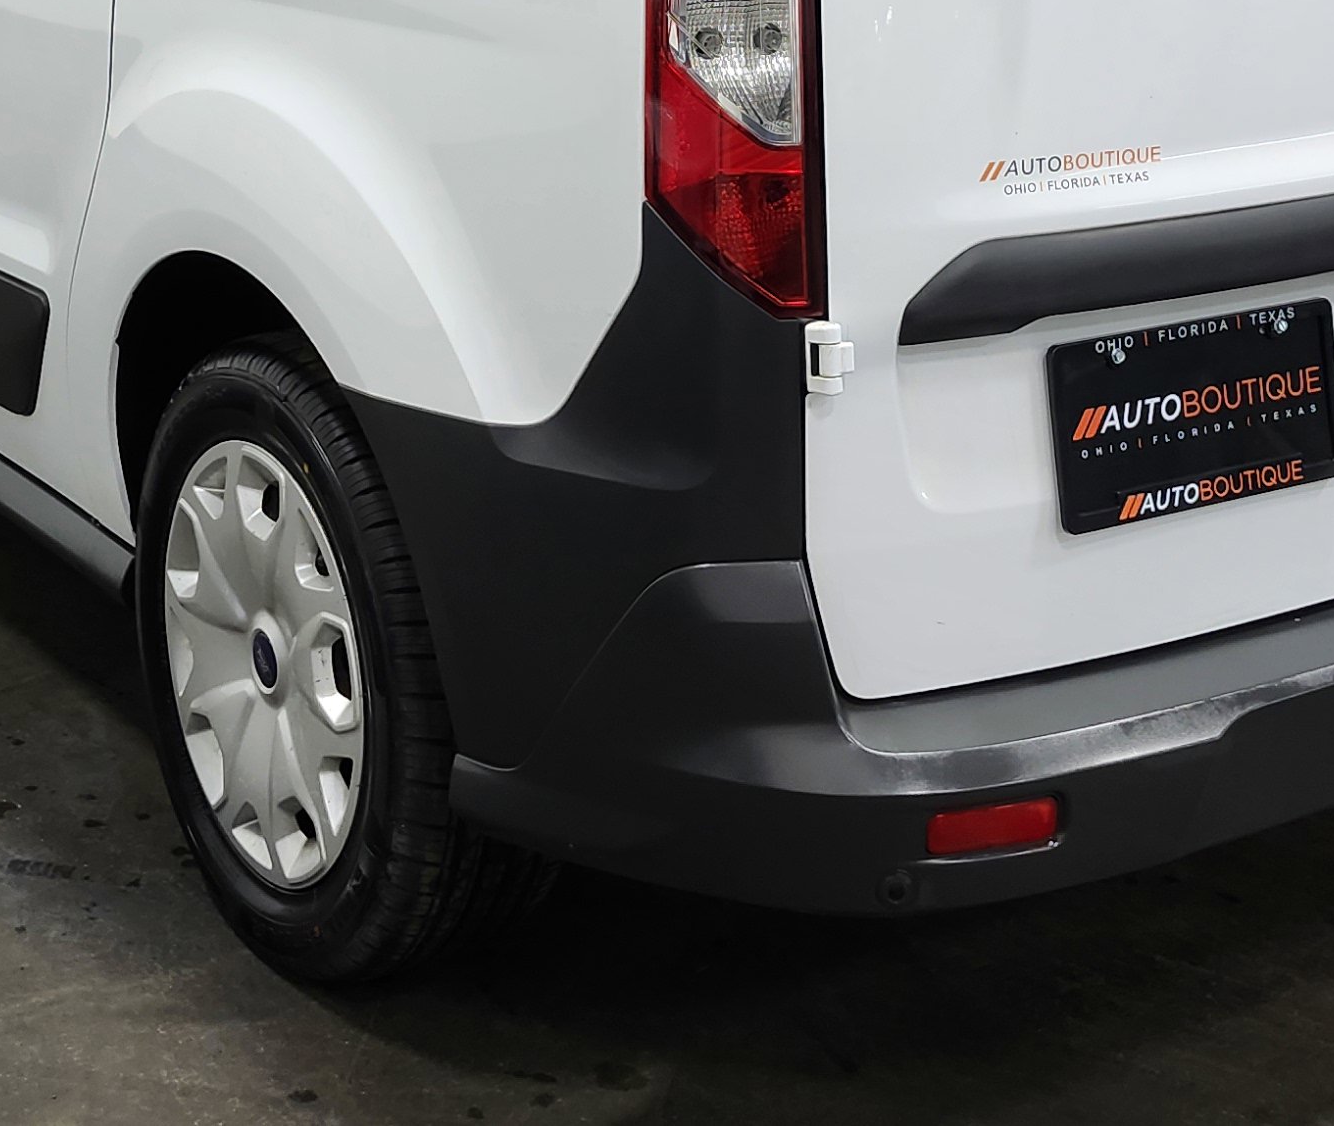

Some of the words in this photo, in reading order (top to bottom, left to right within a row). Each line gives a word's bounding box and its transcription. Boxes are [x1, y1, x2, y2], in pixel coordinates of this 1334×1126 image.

[1004, 146, 1161, 177] AUTOBOUTIQUE
[1004, 182, 1037, 195] OHIO
[1047, 176, 1100, 191] FLORIDA
[1109, 171, 1149, 185] TEXAS
[1095, 335, 1134, 354] OHIO
[1157, 319, 1229, 342] FLORIDA
[1249, 307, 1295, 326] TEXAS
[1100, 366, 1322, 434] AUTOBOUTIQUE
[1081, 442, 1127, 459] OHIO
[1152, 421, 1235, 445] FLORIDA
[1260, 404, 1317, 423] TEXAS
[1140, 460, 1304, 515] AUTOBOUTIQUE
